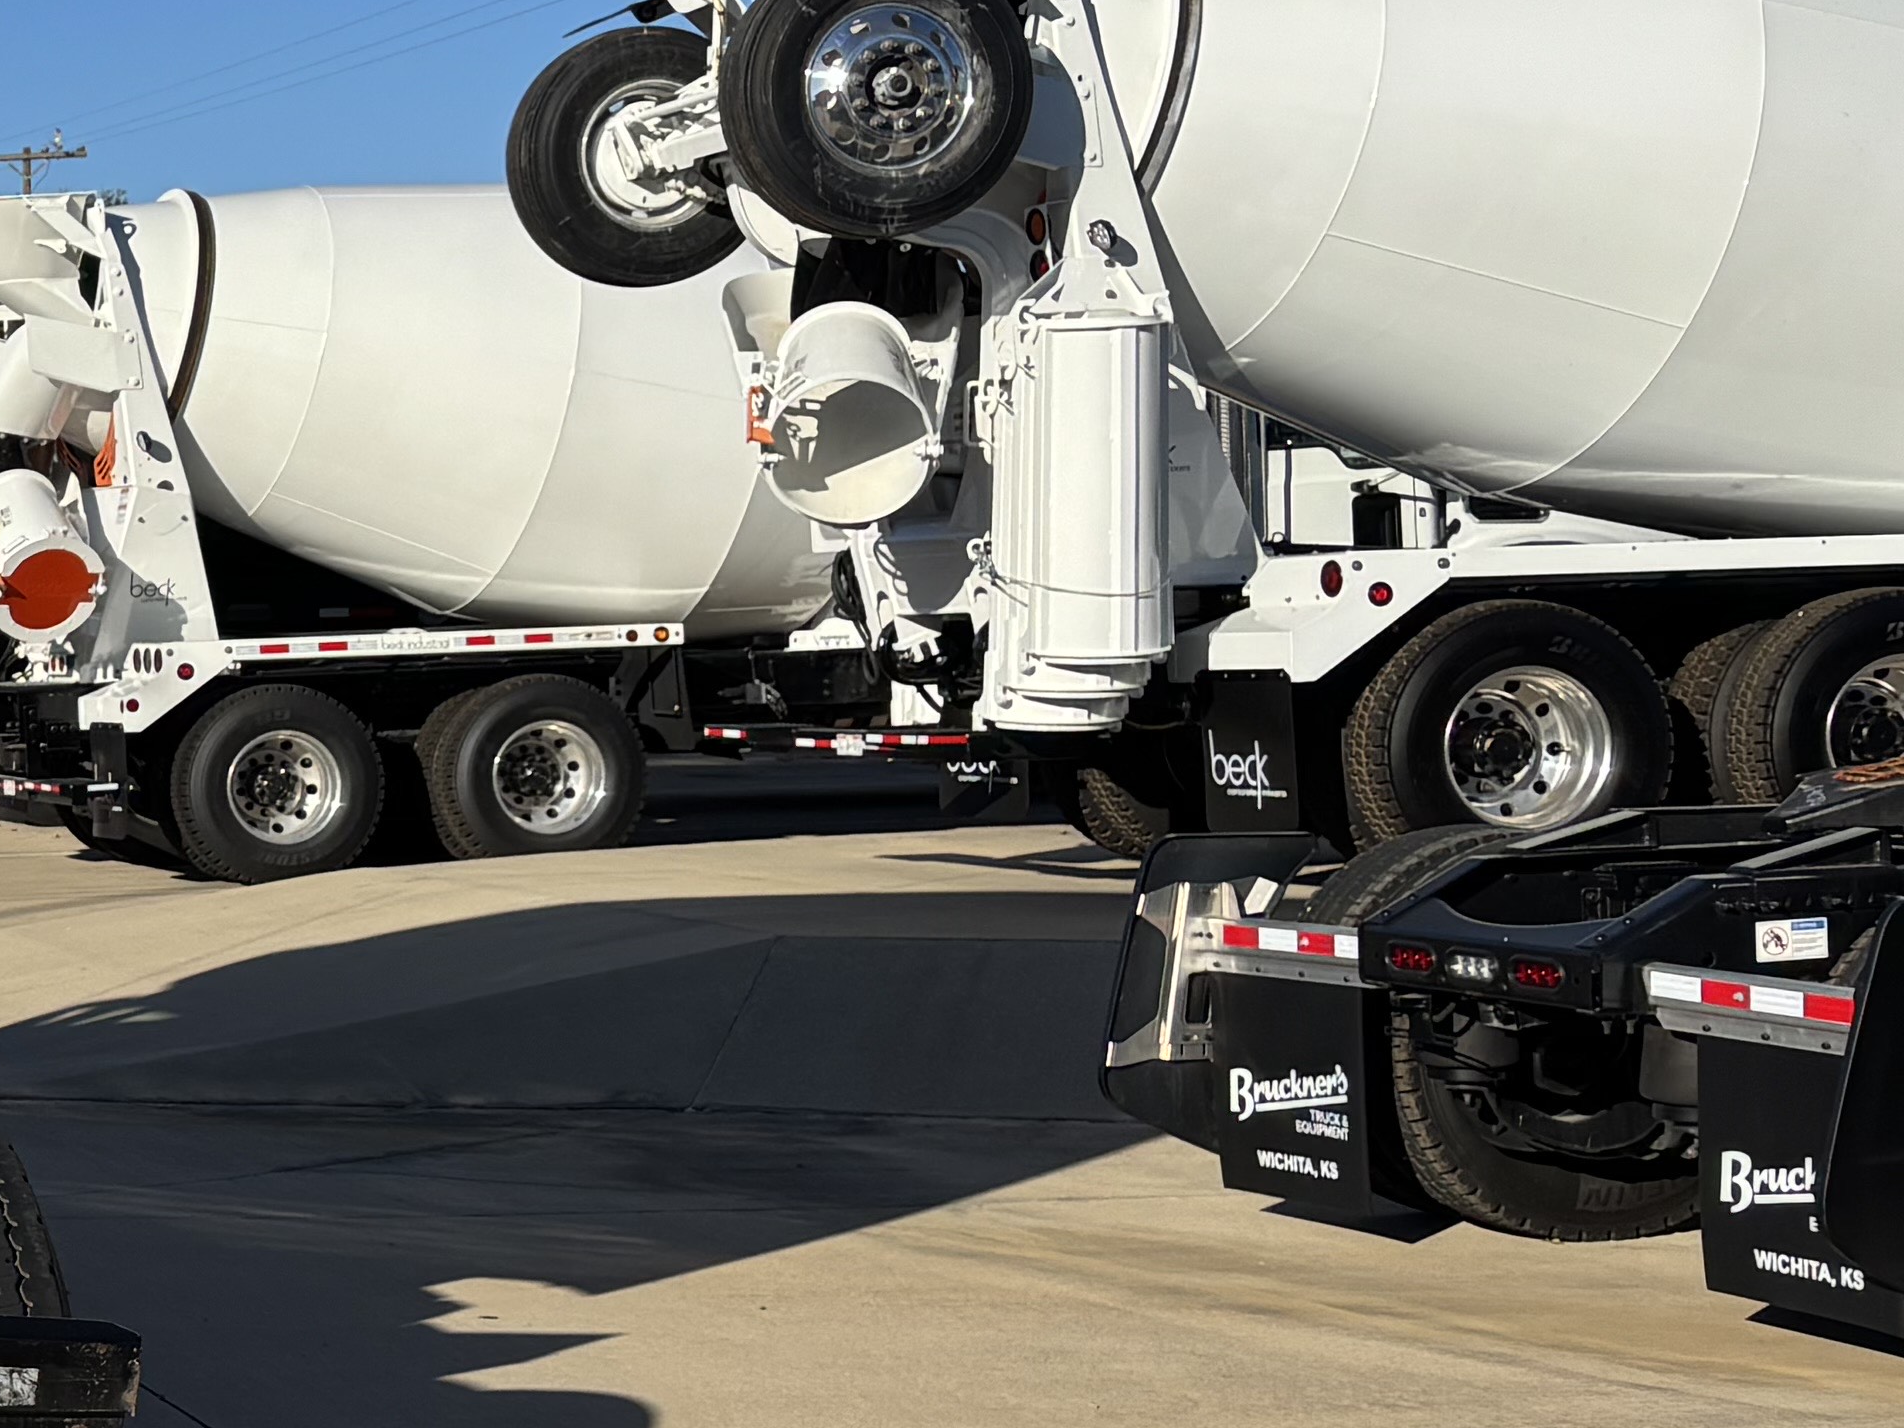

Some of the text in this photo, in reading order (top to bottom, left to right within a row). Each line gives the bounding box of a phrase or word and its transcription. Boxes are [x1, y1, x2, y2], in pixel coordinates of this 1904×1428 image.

[130, 572, 176, 606] beck
[1208, 729, 1270, 810] beck
[1229, 1063, 1349, 1122] Bruckner's
[1295, 1119, 1349, 1141] EQUIPMENT
[1309, 1109, 1341, 1126] TRUCK
[1256, 1149, 1339, 1180] WICHITA, KS
[1753, 1248, 1865, 1291] WICHITA, KS
